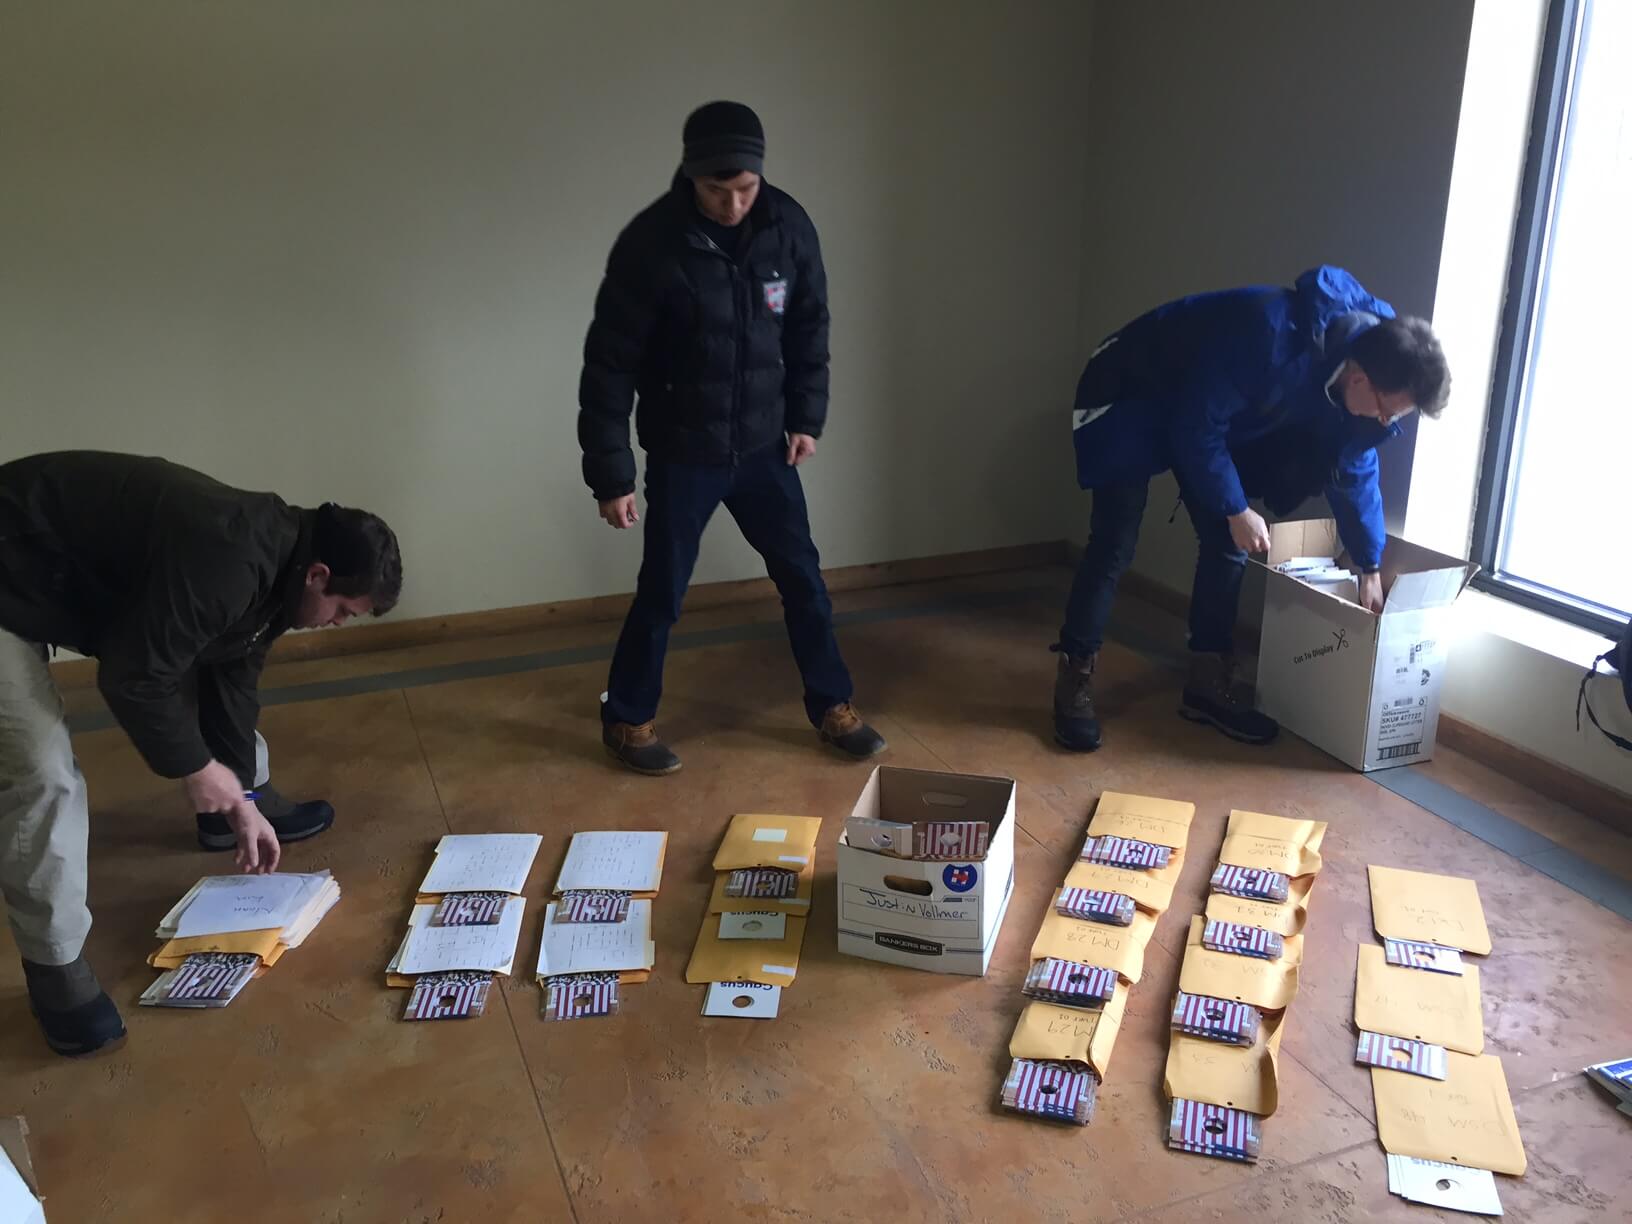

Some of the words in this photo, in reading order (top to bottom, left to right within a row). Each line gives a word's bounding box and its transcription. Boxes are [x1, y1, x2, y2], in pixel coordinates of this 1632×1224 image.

[1312, 645, 1334, 658] Display
[859, 887, 915, 914] Justin
[918, 903, 968, 920] Vollmer
[879, 935, 919, 949] BANKERS
[919, 943, 938, 953] BOX
[720, 981, 773, 991] Caucus
